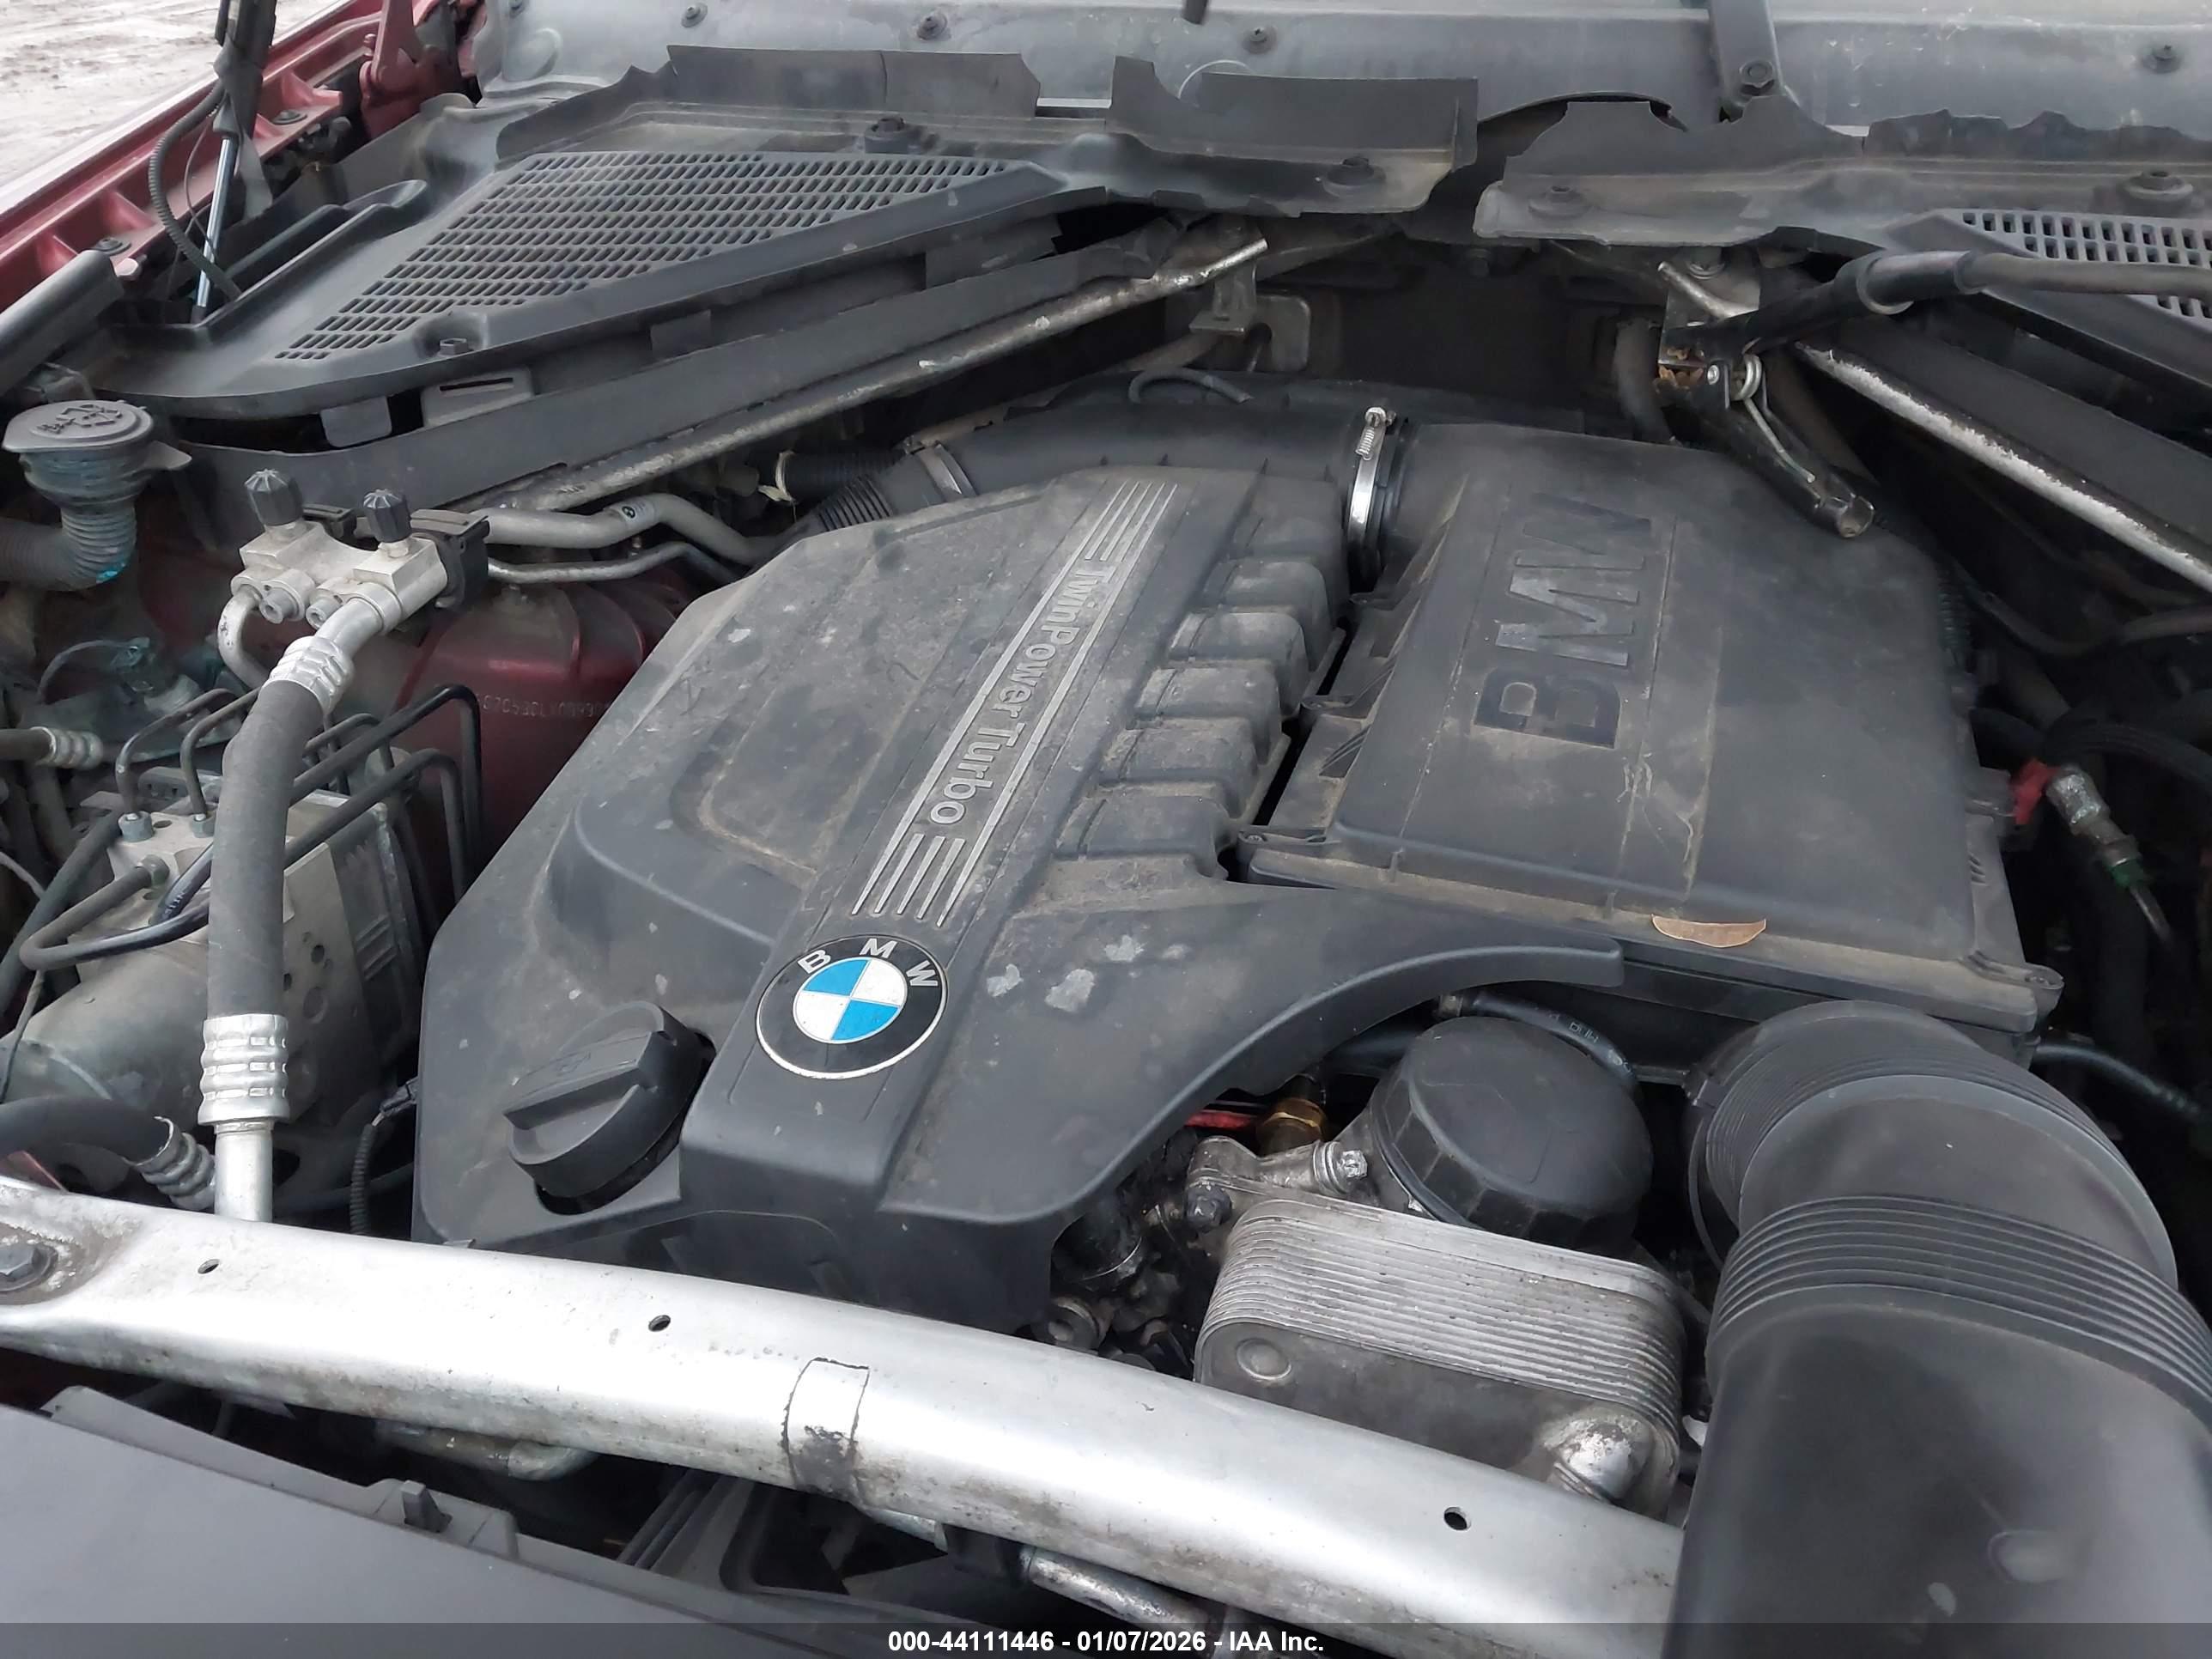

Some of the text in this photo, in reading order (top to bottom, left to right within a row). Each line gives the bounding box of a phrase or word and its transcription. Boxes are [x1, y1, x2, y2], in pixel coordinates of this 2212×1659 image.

[930, 566, 1116, 825] TwinPower Turbo
[1473, 491, 1651, 750] BMW
[797, 938, 939, 988] BMW
